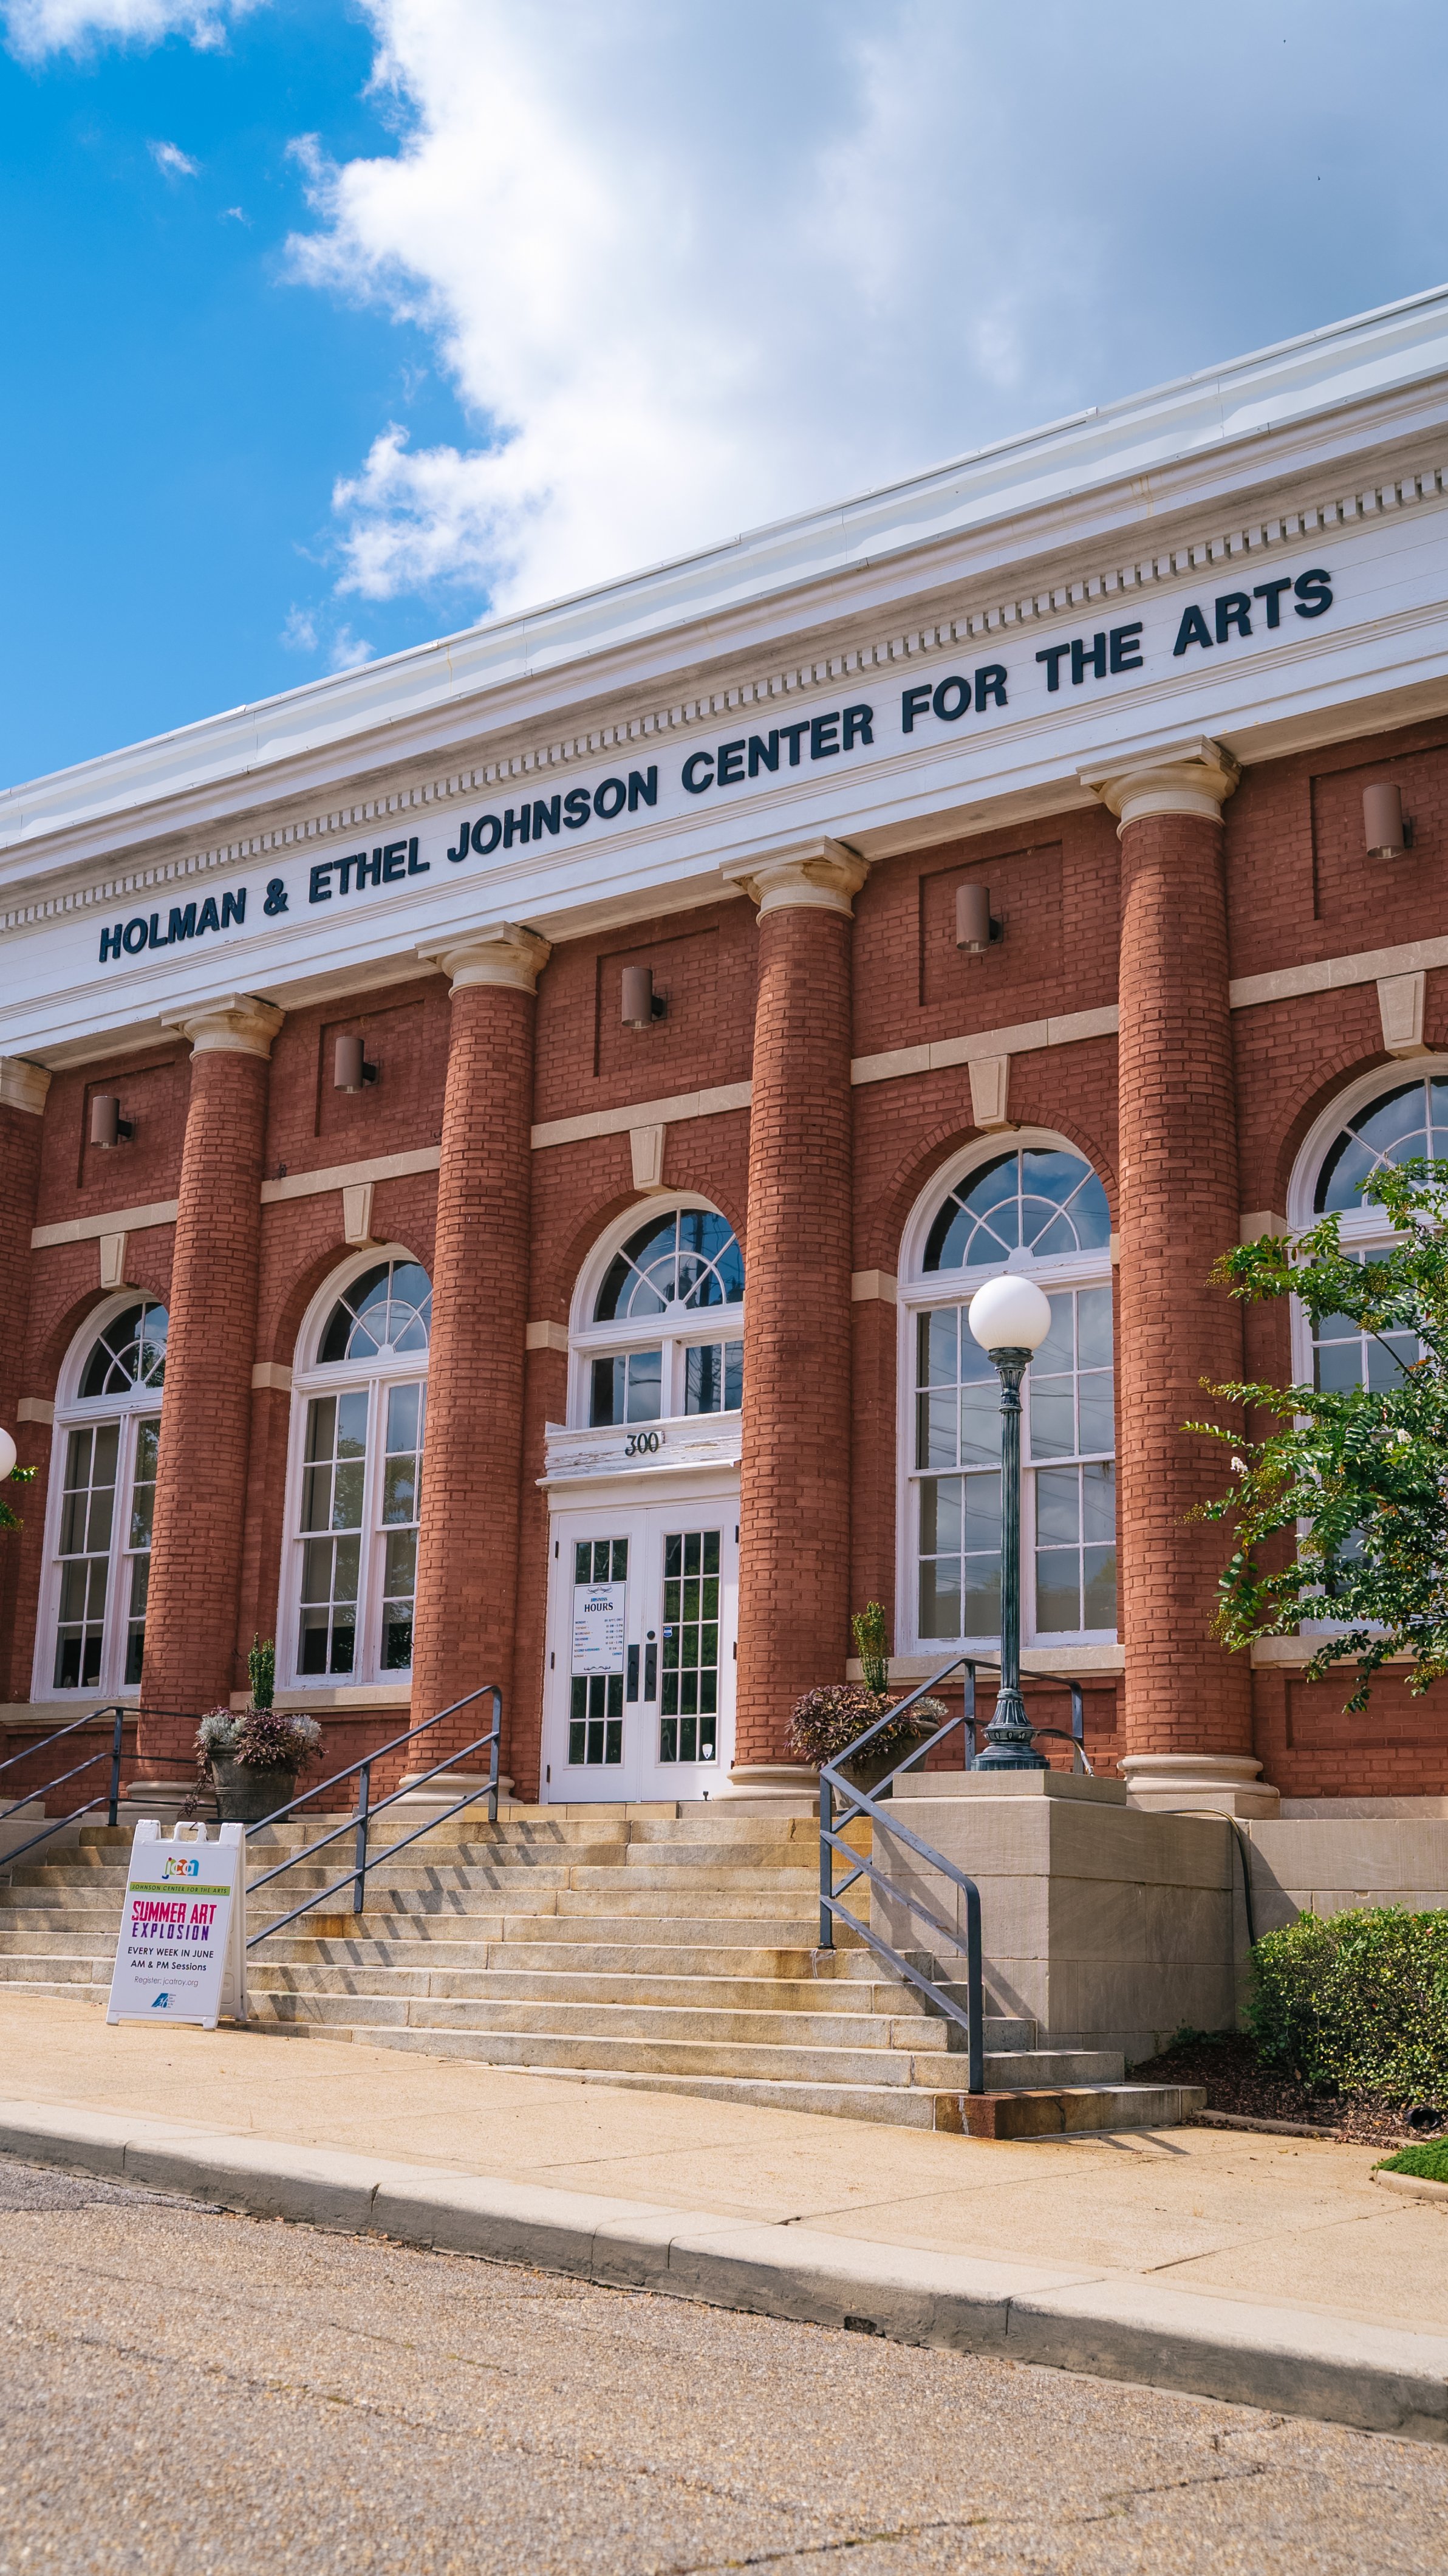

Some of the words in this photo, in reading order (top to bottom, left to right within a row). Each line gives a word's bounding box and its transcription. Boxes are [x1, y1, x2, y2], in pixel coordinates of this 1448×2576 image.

[99, 887, 247, 962] HOLMAN
[264, 879, 289, 916] &
[309, 837, 430, 903] ETHEL
[448, 766, 657, 863] JOHNSON
[681, 704, 874, 794] CENTER
[903, 664, 1008, 733] FOR
[1036, 622, 1144, 692] THE
[1173, 569, 1333, 657] ARTS
[625, 1432, 659, 1456] 300
[584, 1602, 613, 1612] HOURS
[162, 1857, 199, 1880] jca
[131, 1900, 187, 1923] SUMMER
[190, 1903, 217, 1925] ART
[132, 1922, 210, 1941] EXPLOSION
[128, 1947, 154, 1955] EVERY
[156, 1948, 179, 1956] WEEK
[192, 1950, 214, 1958] JUNE
[171, 1962, 207, 1971] Sessions
[134, 1976, 162, 1985] Register:
[162, 1978, 199, 1988] jcatroy.org
